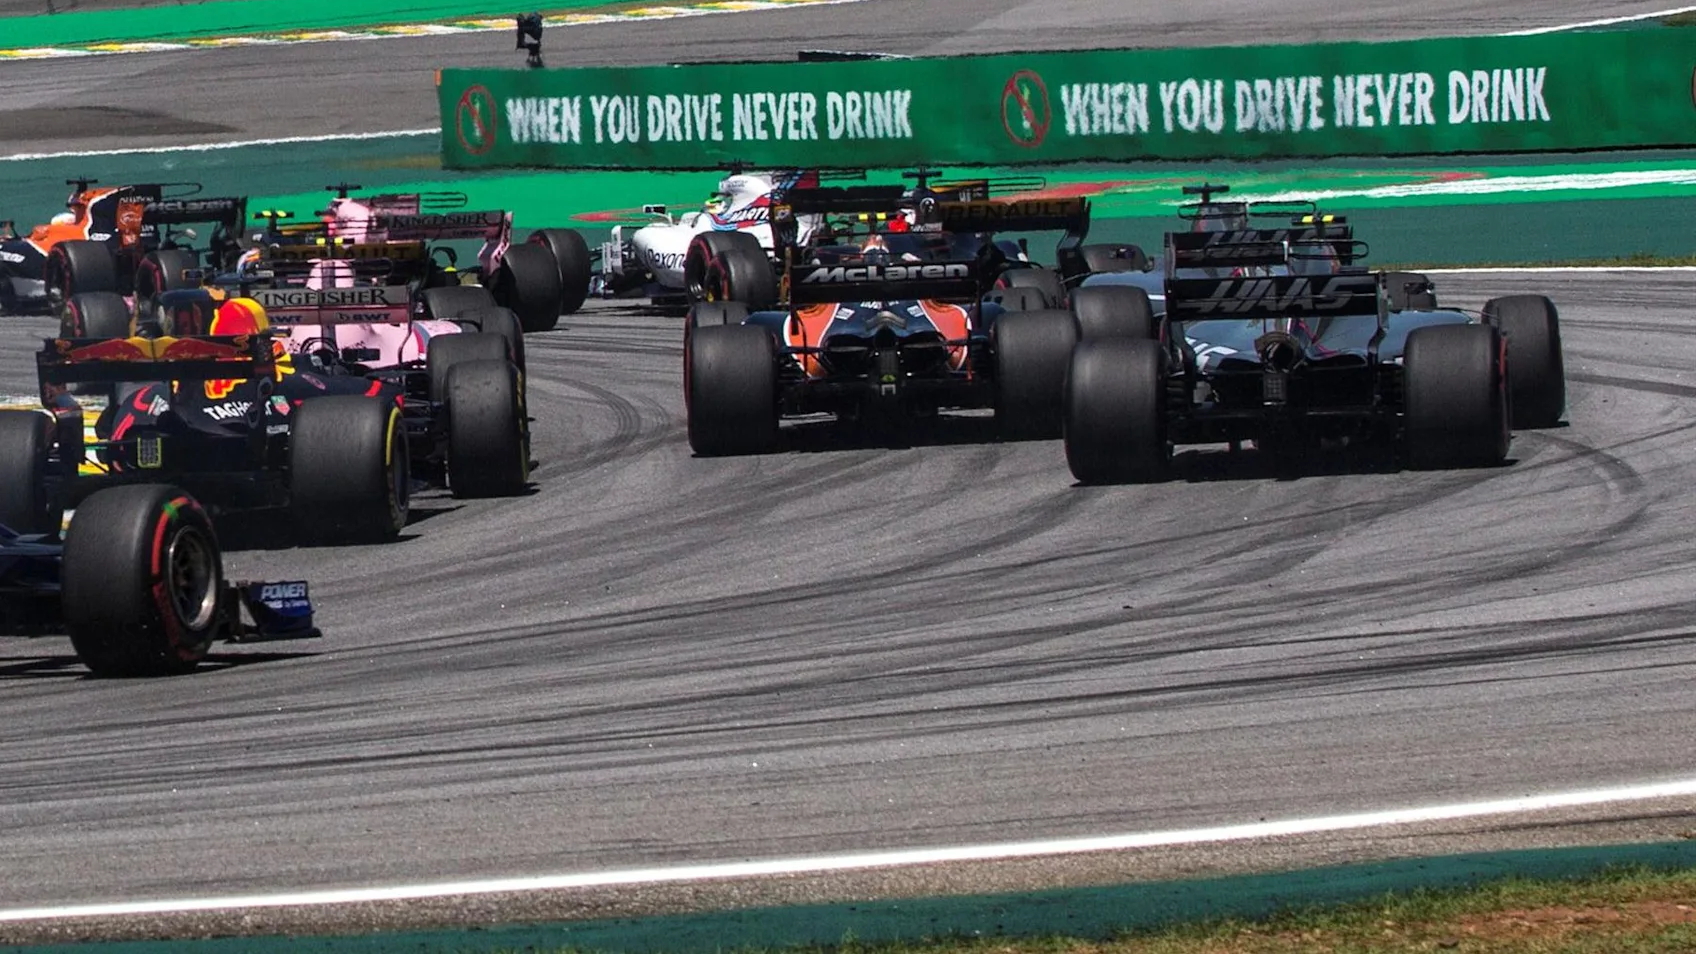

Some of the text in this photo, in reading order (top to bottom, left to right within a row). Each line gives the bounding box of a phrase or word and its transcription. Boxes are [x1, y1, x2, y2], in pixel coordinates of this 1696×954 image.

[1061, 66, 1552, 136] WHEN YOU DRIVE NEVER DRINK
[505, 90, 913, 145] WHEN YOU DRIVE NEVER DRINK
[647, 248, 685, 269] Rexon
[801, 263, 969, 284] McLaren
[1176, 276, 1375, 314] HAAS
[261, 582, 307, 599] POWER
